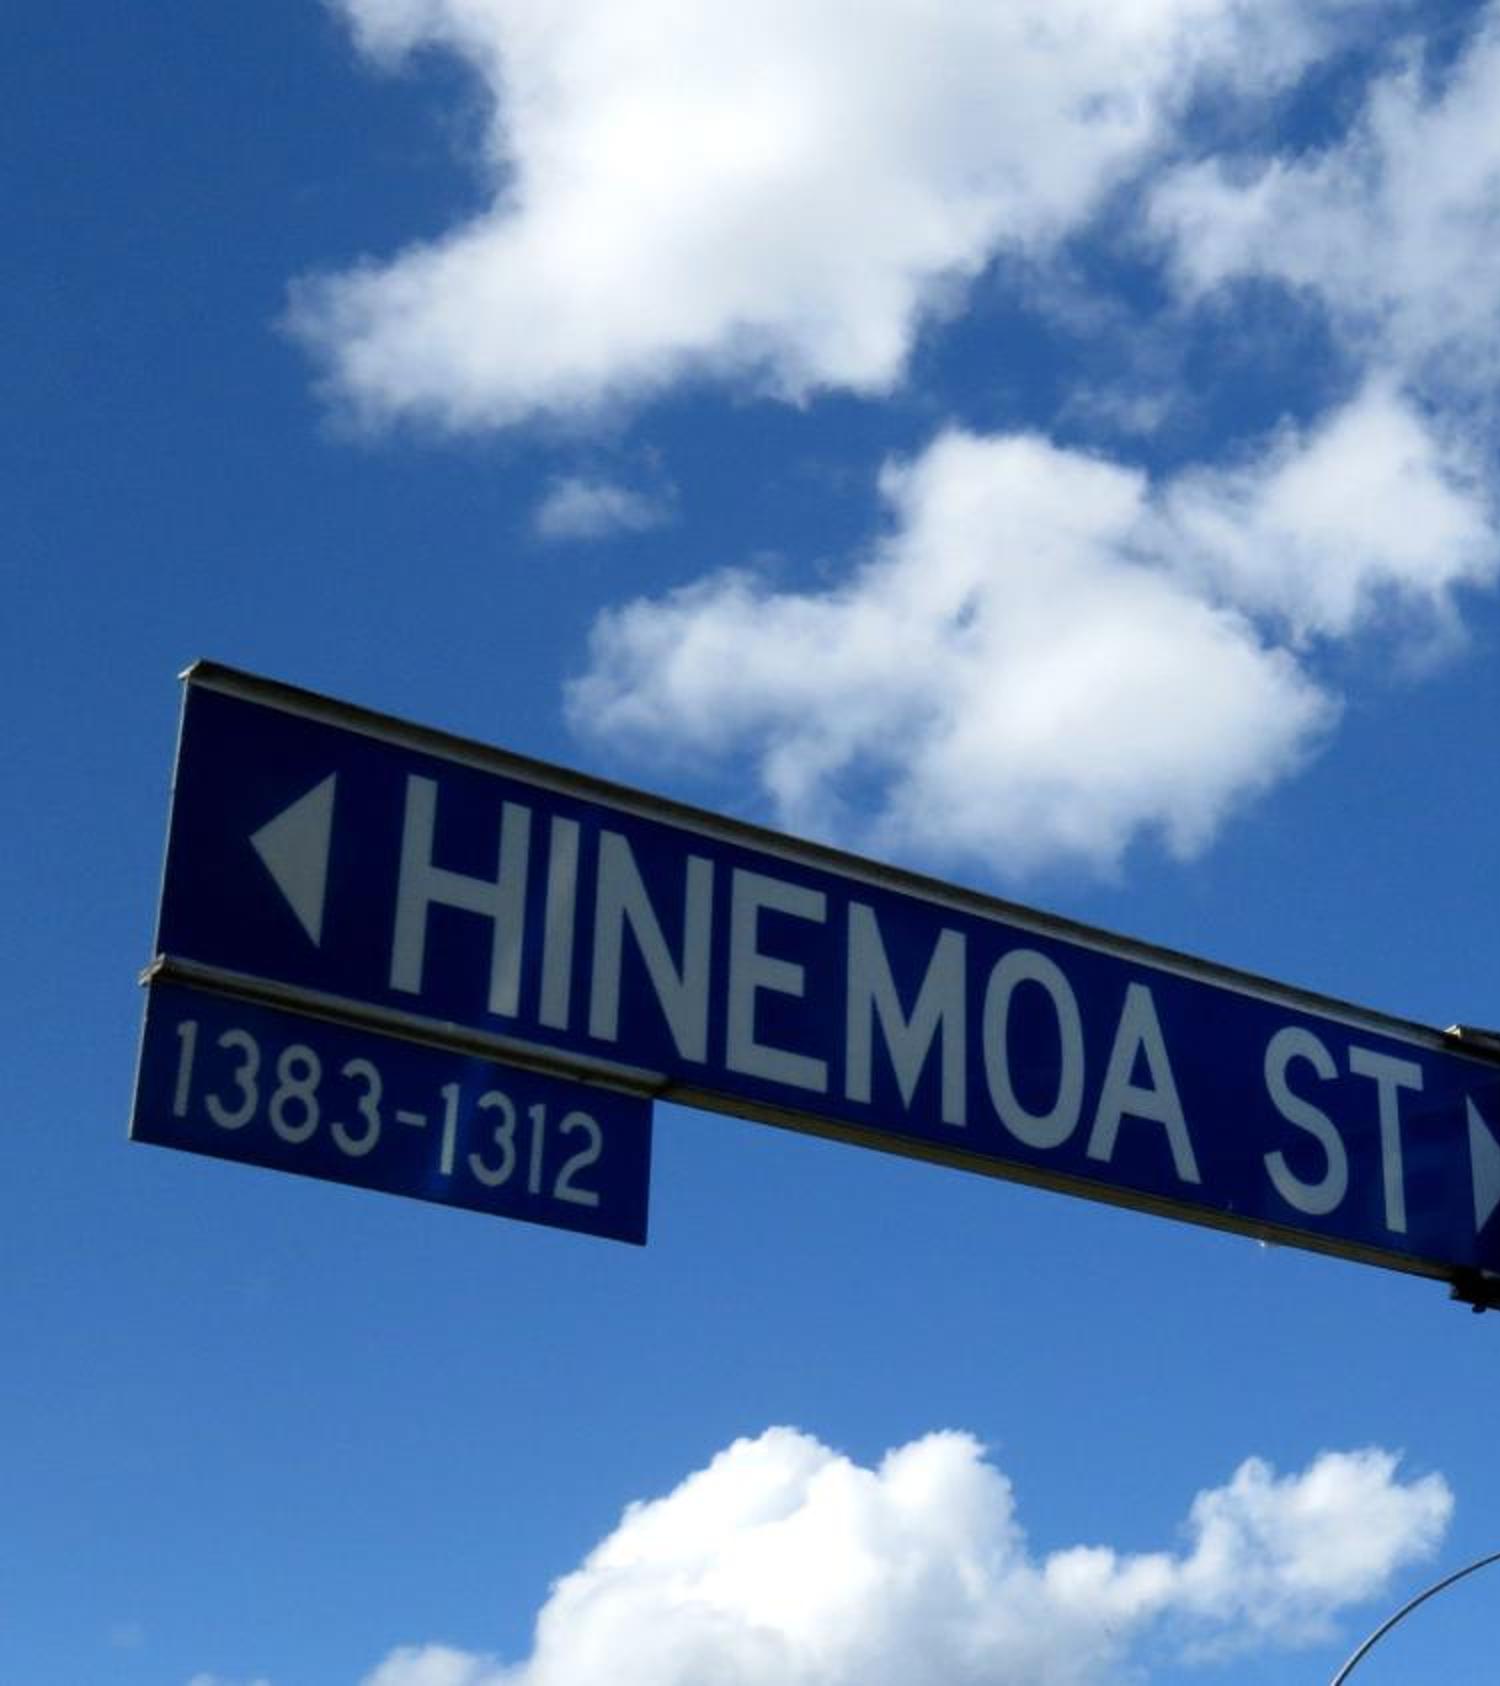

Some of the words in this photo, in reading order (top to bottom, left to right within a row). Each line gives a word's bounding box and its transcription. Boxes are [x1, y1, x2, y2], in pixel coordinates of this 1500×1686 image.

[172, 1019, 604, 1208] 1383-1312
[389, 774, 1201, 1185] HINEMOA
[1263, 1026, 1424, 1235] ST
